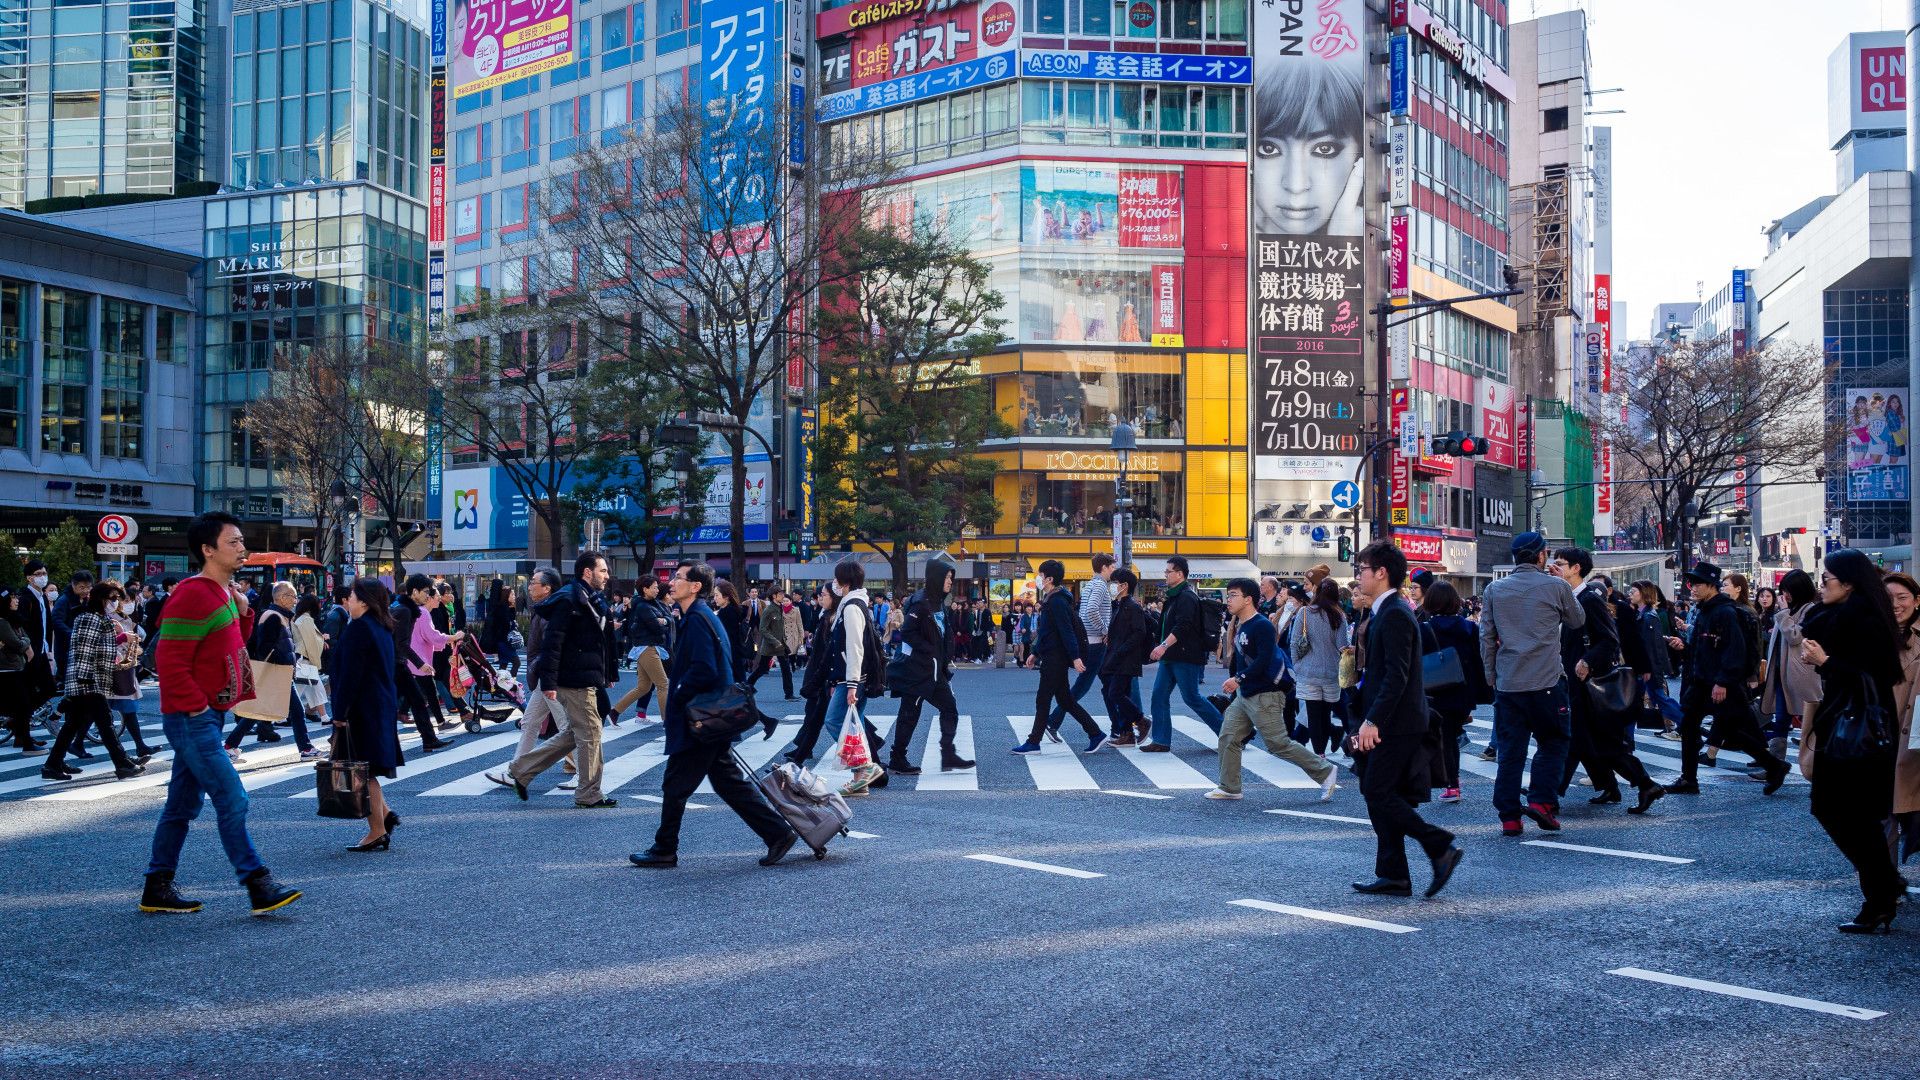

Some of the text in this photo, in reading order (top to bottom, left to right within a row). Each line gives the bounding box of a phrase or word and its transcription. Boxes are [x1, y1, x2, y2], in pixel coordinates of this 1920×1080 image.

[434, 0, 444, 52] 急リバブル
[793, 0, 802, 42] ルーム
[985, 21, 1012, 36] ガスト
[1133, 13, 1152, 21] ガスト
[1311, 0, 1357, 58] み
[434, 57, 444, 65] 9F
[857, 43, 889, 67] Café
[892, 22, 971, 75] ガスト
[480, 58, 493, 72] 4F
[823, 54, 850, 82] 7F
[857, 63, 889, 79] レストラン
[1029, 54, 1248, 80] AEON 英会話イーオン
[1868, 54, 1906, 78] UN
[868, 65, 980, 107] 英会話イーオン
[987, 59, 1005, 76] 6F
[1869, 81, 1906, 108] QL
[435, 92, 445, 144] アメリカン
[706, 15, 738, 208] アイシティ
[432, 146, 445, 156] 8F
[1394, 133, 1405, 200] 渋谷駅前ビル
[433, 166, 443, 206] 外貨両替
[1120, 177, 1157, 196] 沖縄
[1120, 197, 1179, 205] フォトウェディング
[1392, 217, 1408, 226] 5F
[251, 240, 316, 254] SHIBUYA
[1258, 240, 1360, 270] 国立代々木
[218, 250, 357, 273] MARK CITY
[253, 280, 313, 293] 渋谷 マークシティ
[431, 261, 443, 327] 加藤眼科
[1258, 271, 1361, 301] 競技場第一
[1597, 286, 1608, 310] 免税
[1160, 272, 1175, 328] 毎日開催
[1259, 300, 1351, 332] 体育館 3
[1330, 317, 1359, 336] Days!
[1296, 340, 1324, 351] 2016
[1587, 333, 1600, 355] OS
[1265, 358, 1354, 387] 7月8日(金)
[1265, 390, 1354, 419] 7月9日(土)
[1261, 422, 1359, 451] 7月10日(日)
[1488, 414, 1509, 440] アコム
[1494, 446, 1503, 460] 3F
[1393, 508, 1408, 523] 薬
[1483, 498, 1513, 527] LUSH
[99, 544, 126, 554] ここまで
[1410, 540, 1436, 555] サンドラッグ
